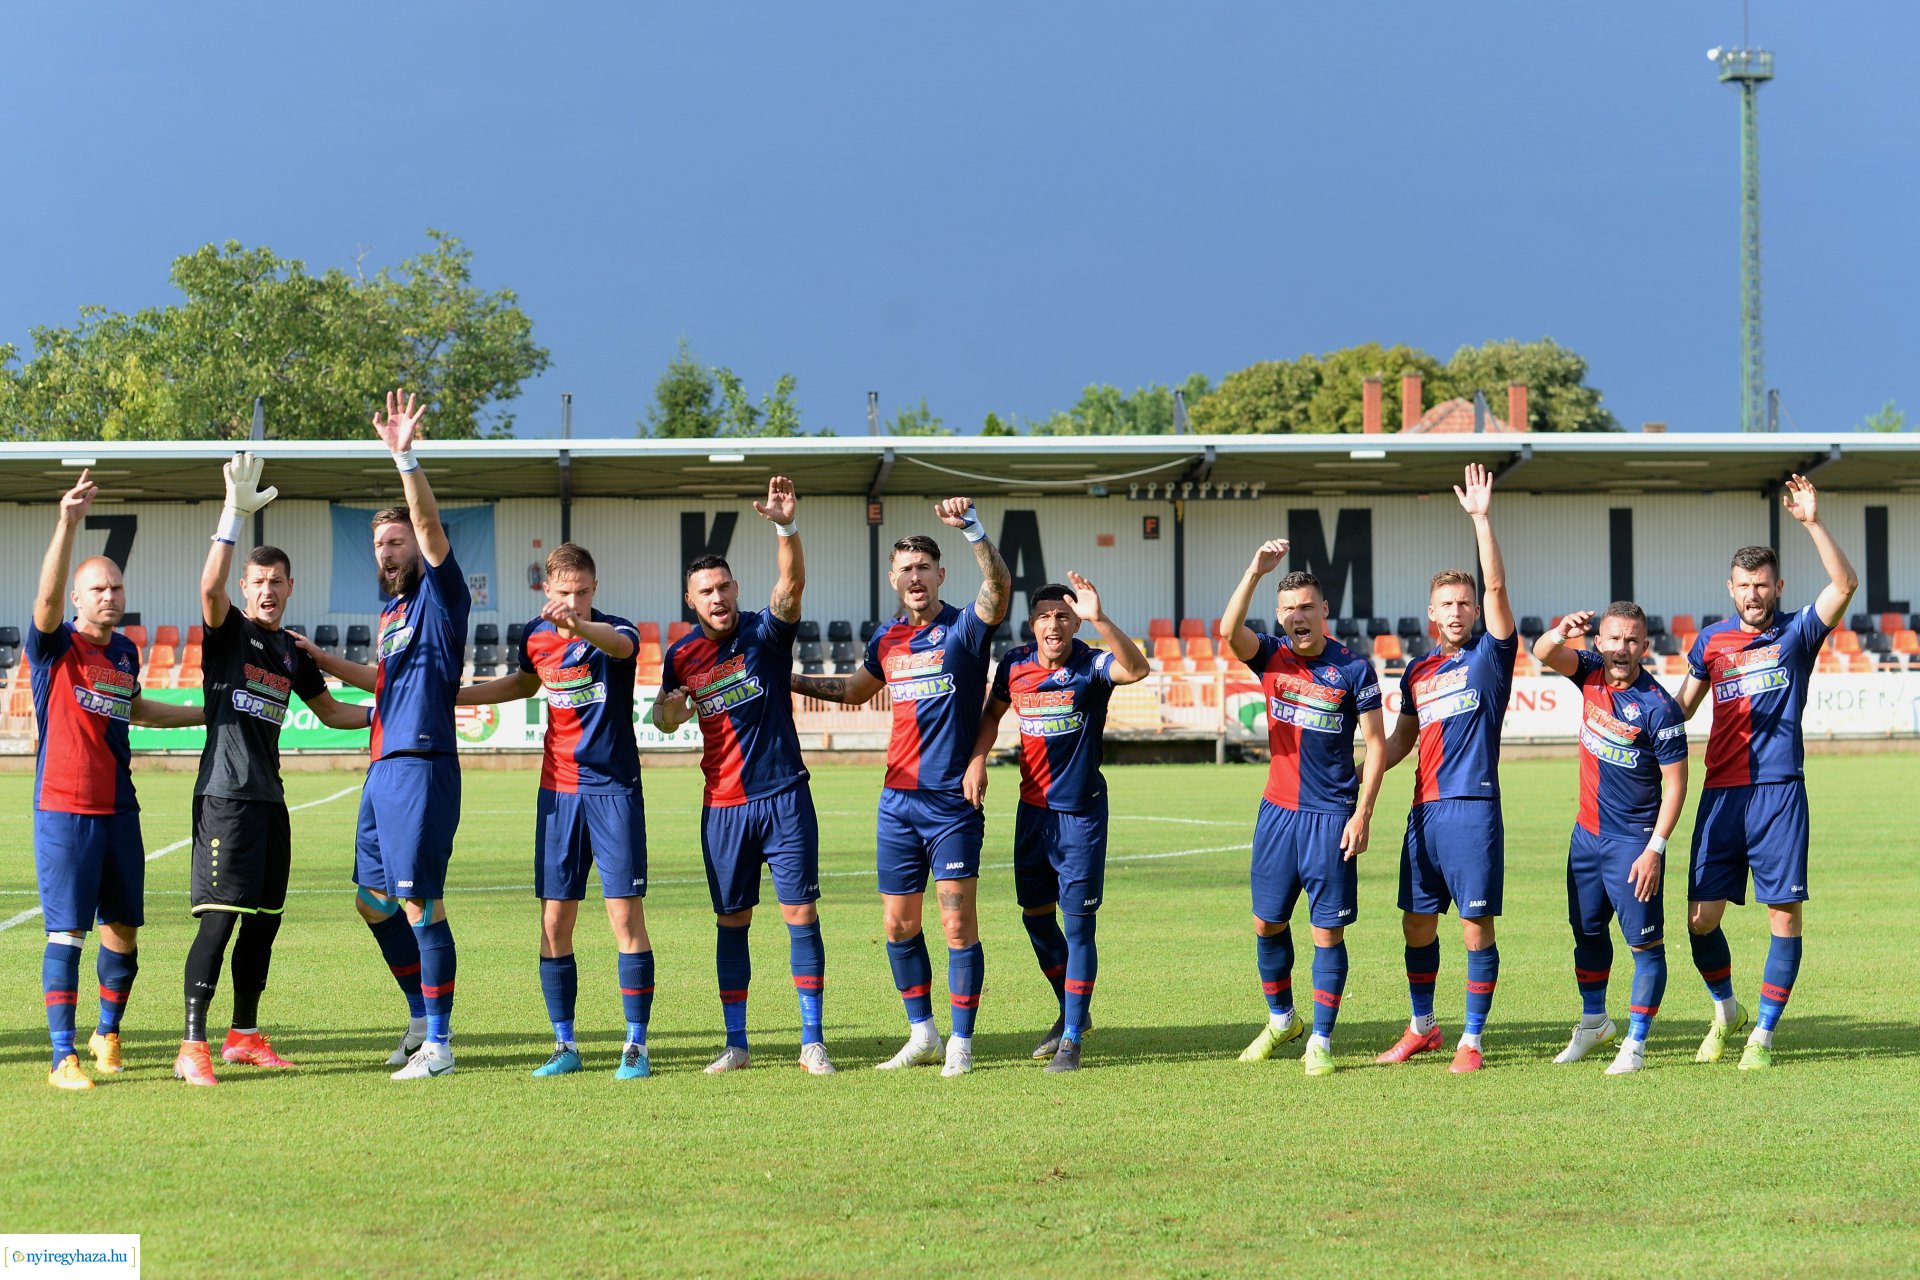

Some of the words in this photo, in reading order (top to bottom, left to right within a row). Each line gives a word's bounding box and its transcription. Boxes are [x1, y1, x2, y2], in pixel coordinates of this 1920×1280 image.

[869, 503, 881, 519] E
[1145, 518, 1158, 533] F
[886, 649, 945, 673] REVESZ
[1714, 643, 1781, 673] REVESZ
[537, 663, 591, 682] REVESZ
[687, 653, 746, 691] REVESZ
[1274, 672, 1347, 704] REVESZ
[1011, 689, 1076, 708] REVESZ
[1584, 700, 1642, 741] REVESZ
[945, 861, 964, 870] JAKO
[1468, 900, 1487, 908] JAKO
[1640, 924, 1655, 936] JAKO
